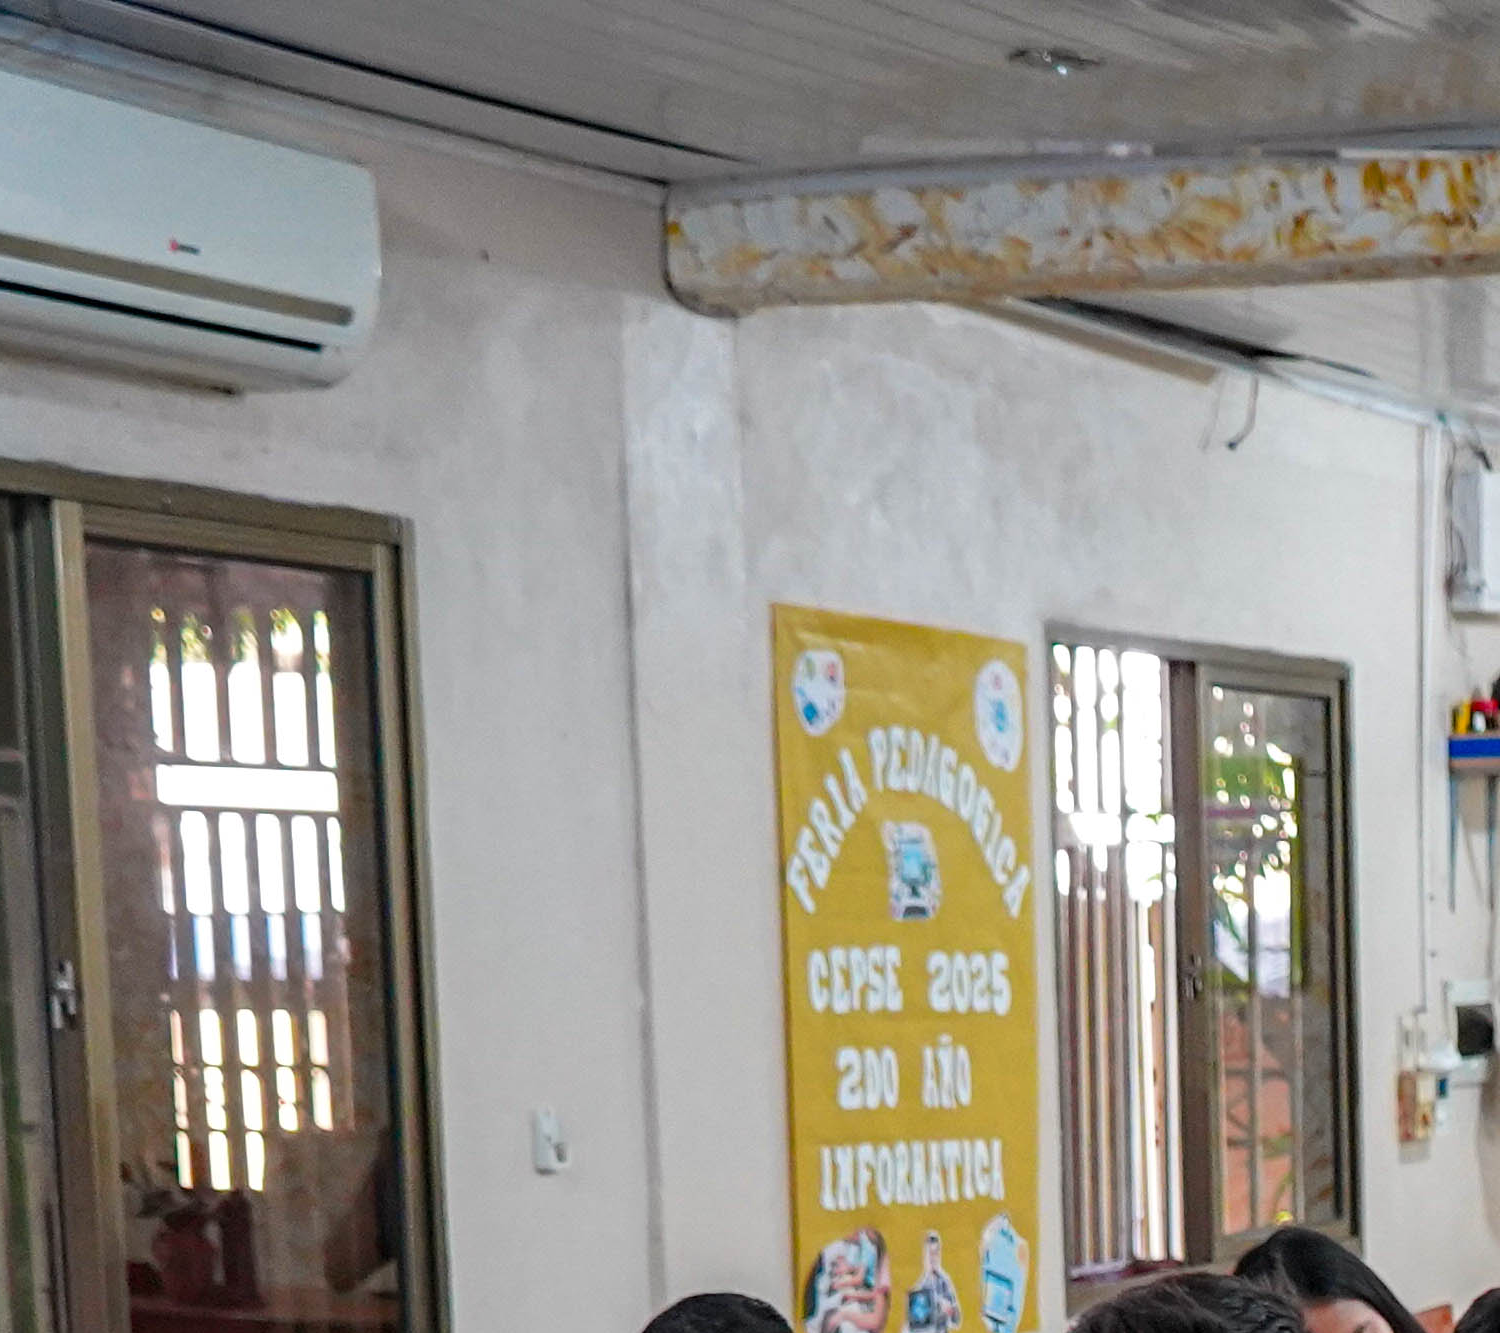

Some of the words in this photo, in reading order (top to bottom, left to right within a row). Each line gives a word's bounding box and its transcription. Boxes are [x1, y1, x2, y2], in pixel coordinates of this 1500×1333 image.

[786, 746, 868, 915] FERIA
[867, 725, 1031, 918] PEDAGOGICA
[807, 944, 904, 1014] CEPSE
[926, 949, 1012, 1016] 2025
[820, 1136, 1005, 1211] INFORMATICA
